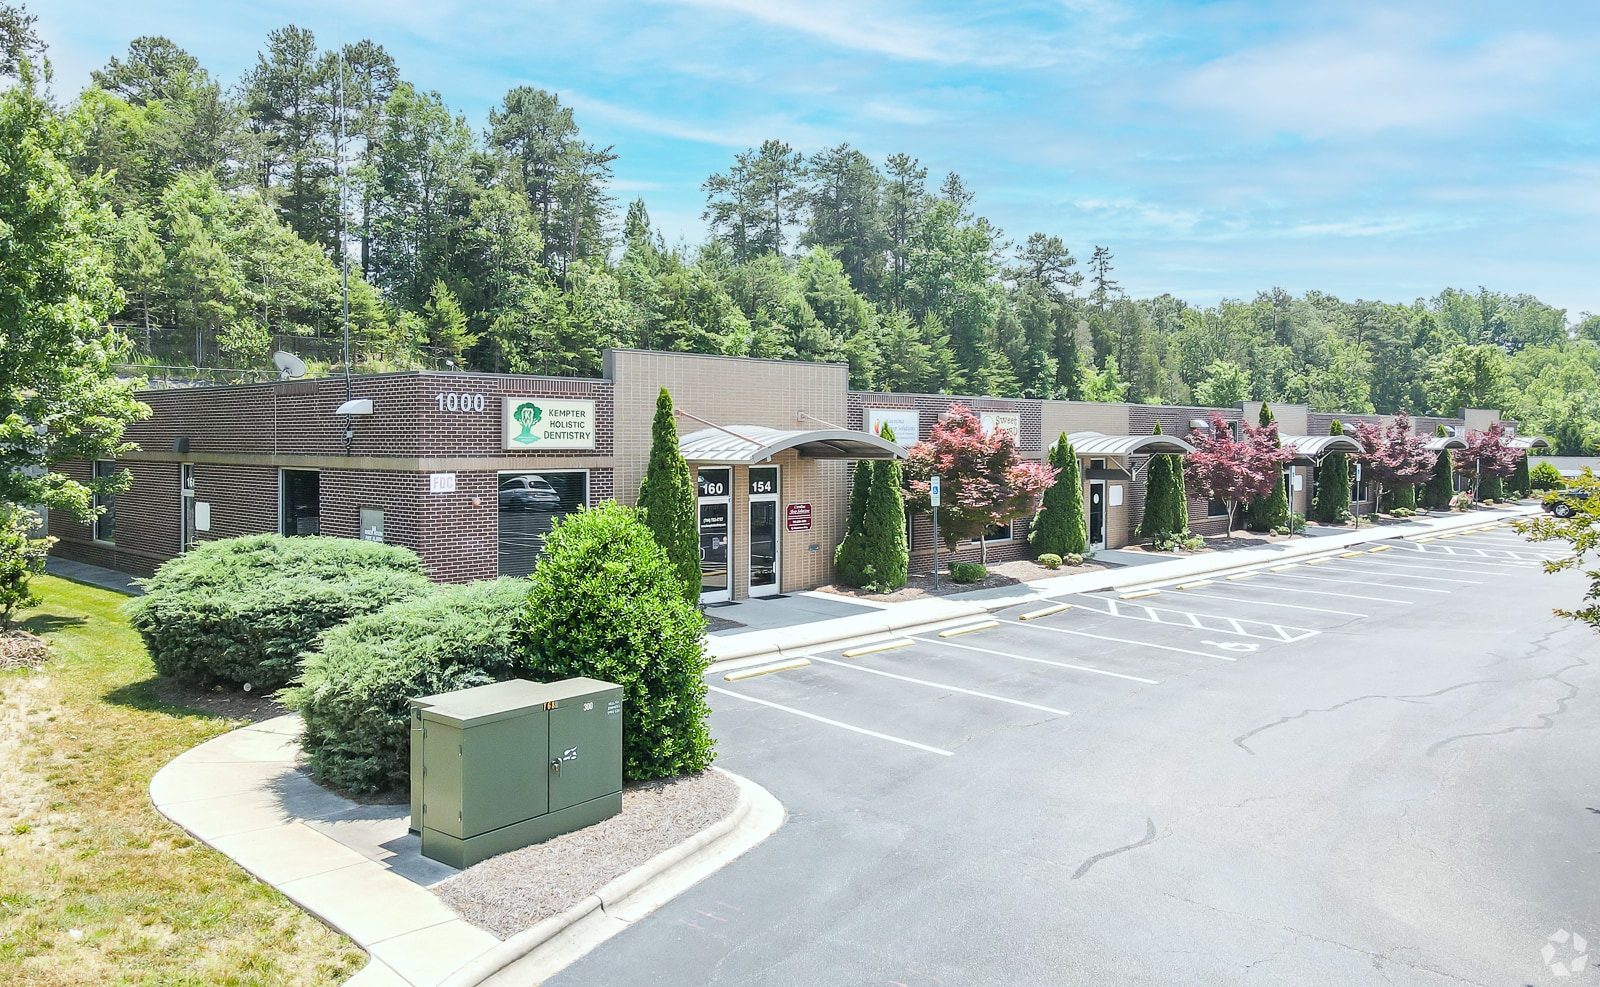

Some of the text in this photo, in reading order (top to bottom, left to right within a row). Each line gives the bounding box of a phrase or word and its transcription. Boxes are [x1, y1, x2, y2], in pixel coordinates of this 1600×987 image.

[435, 392, 485, 412] 1000
[548, 409, 586, 418] KEMPTER
[550, 420, 585, 429] HOLISTIC
[996, 416, 1017, 425] Sweet
[543, 430, 591, 440] DENTISTRY
[433, 476, 453, 489] FDC
[752, 481, 771, 492] 154
[703, 483, 724, 495] 160
[583, 702, 594, 711] 300
